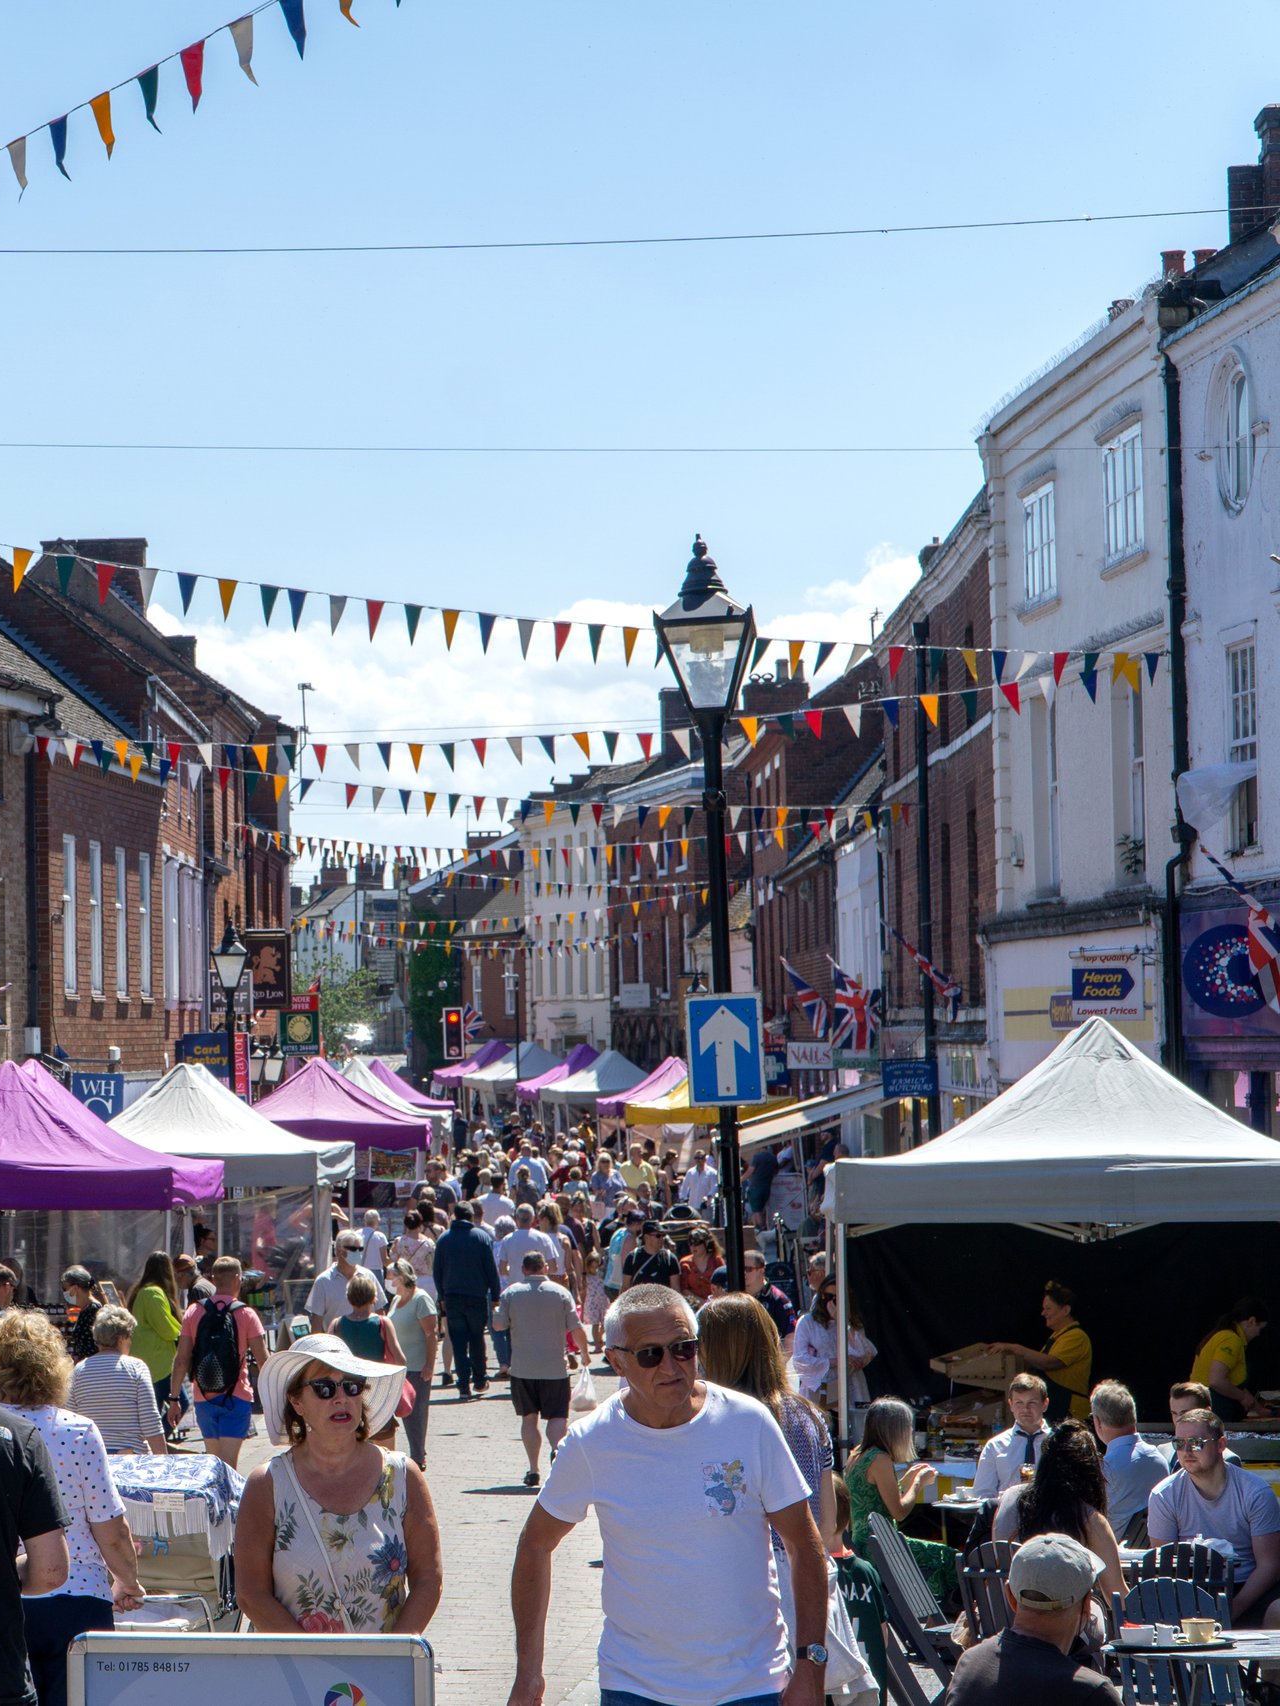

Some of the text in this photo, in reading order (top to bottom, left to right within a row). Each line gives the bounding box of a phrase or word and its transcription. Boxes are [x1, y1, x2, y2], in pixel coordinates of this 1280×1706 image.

[1100, 953, 1130, 963] Quality
[212, 975, 249, 986] HF
[1082, 971, 1122, 983] Heron
[1083, 985, 1121, 997] Foods
[1076, 1007, 1107, 1016] Lowest
[1109, 1007, 1138, 1016] Prices
[193, 1045, 220, 1055] Card
[186, 1056, 228, 1065] Factory
[792, 1047, 831, 1065] NAILS
[80, 1079, 116, 1096] WH
[96, 1661, 190, 1673] Tel: 01785 848157
